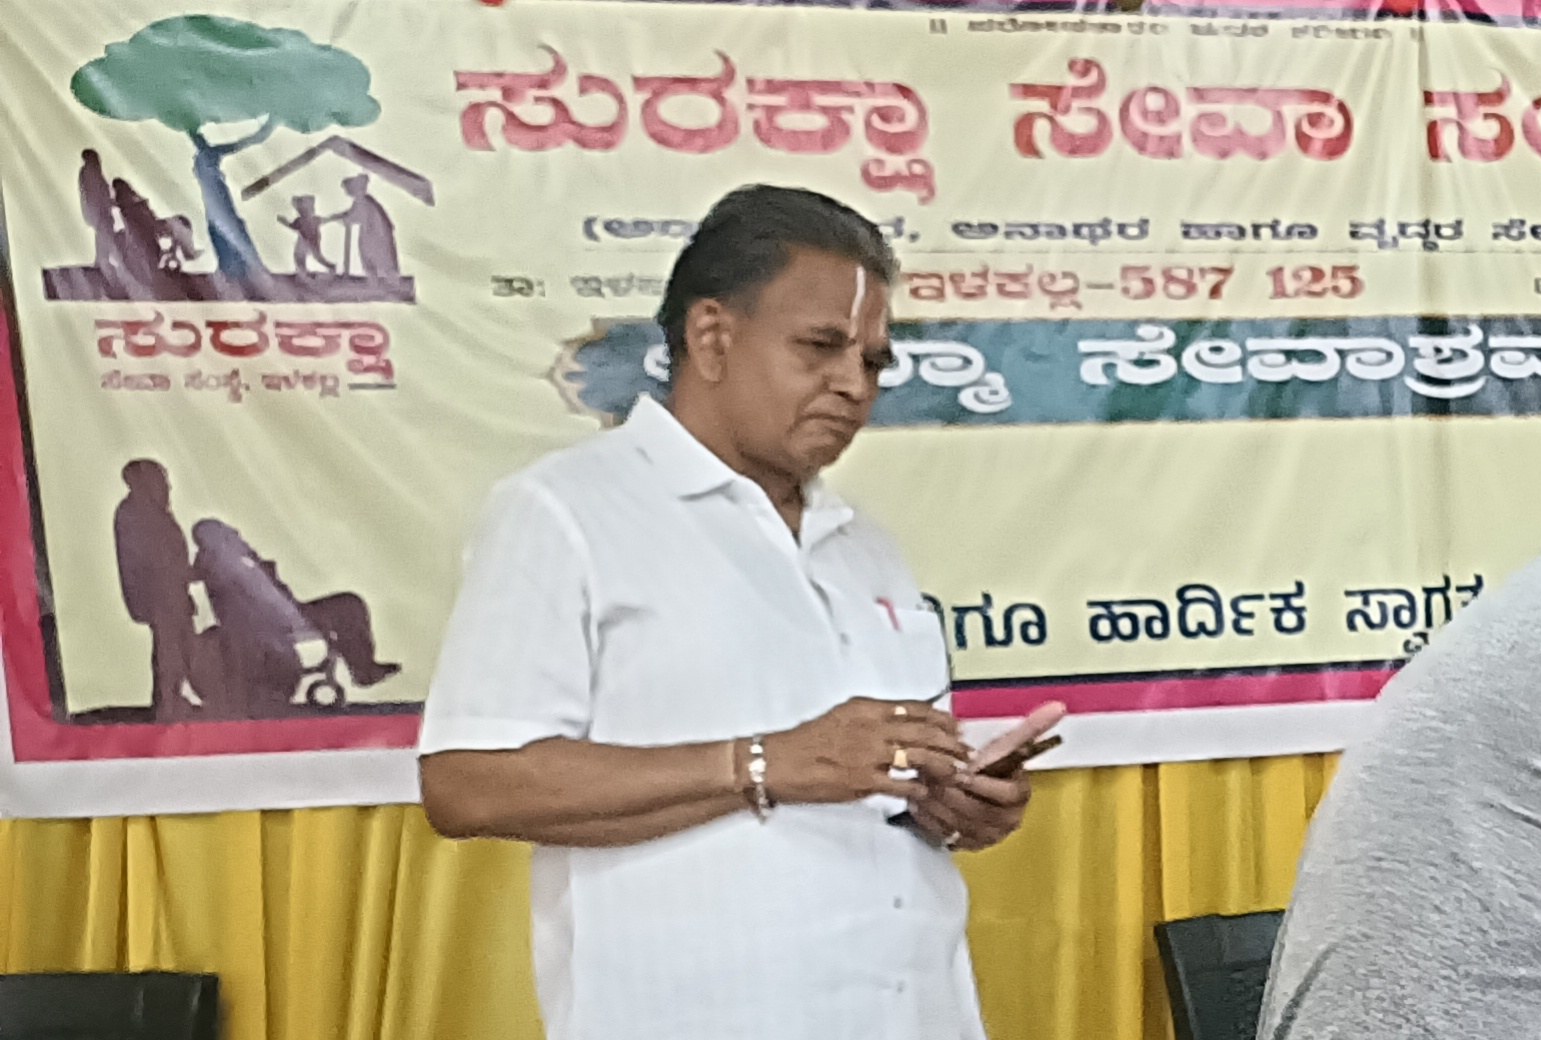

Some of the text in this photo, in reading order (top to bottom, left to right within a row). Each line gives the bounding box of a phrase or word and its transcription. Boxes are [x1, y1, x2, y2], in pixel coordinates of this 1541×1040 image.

[453, 43, 937, 205] ಸುರಕ್ಷಾ
[1008, 57, 1354, 161] ಸೇವಾ
[950, 216, 1150, 246] ಅನಾಥರ
[1180, 218, 1319, 242] ಹಾಗೂ
[1265, 264, 1364, 300] 125
[94, 310, 395, 380] ಸುರಕ್ಷಾ
[1086, 580, 1307, 643] ಹಾರ್ದಿಕ
